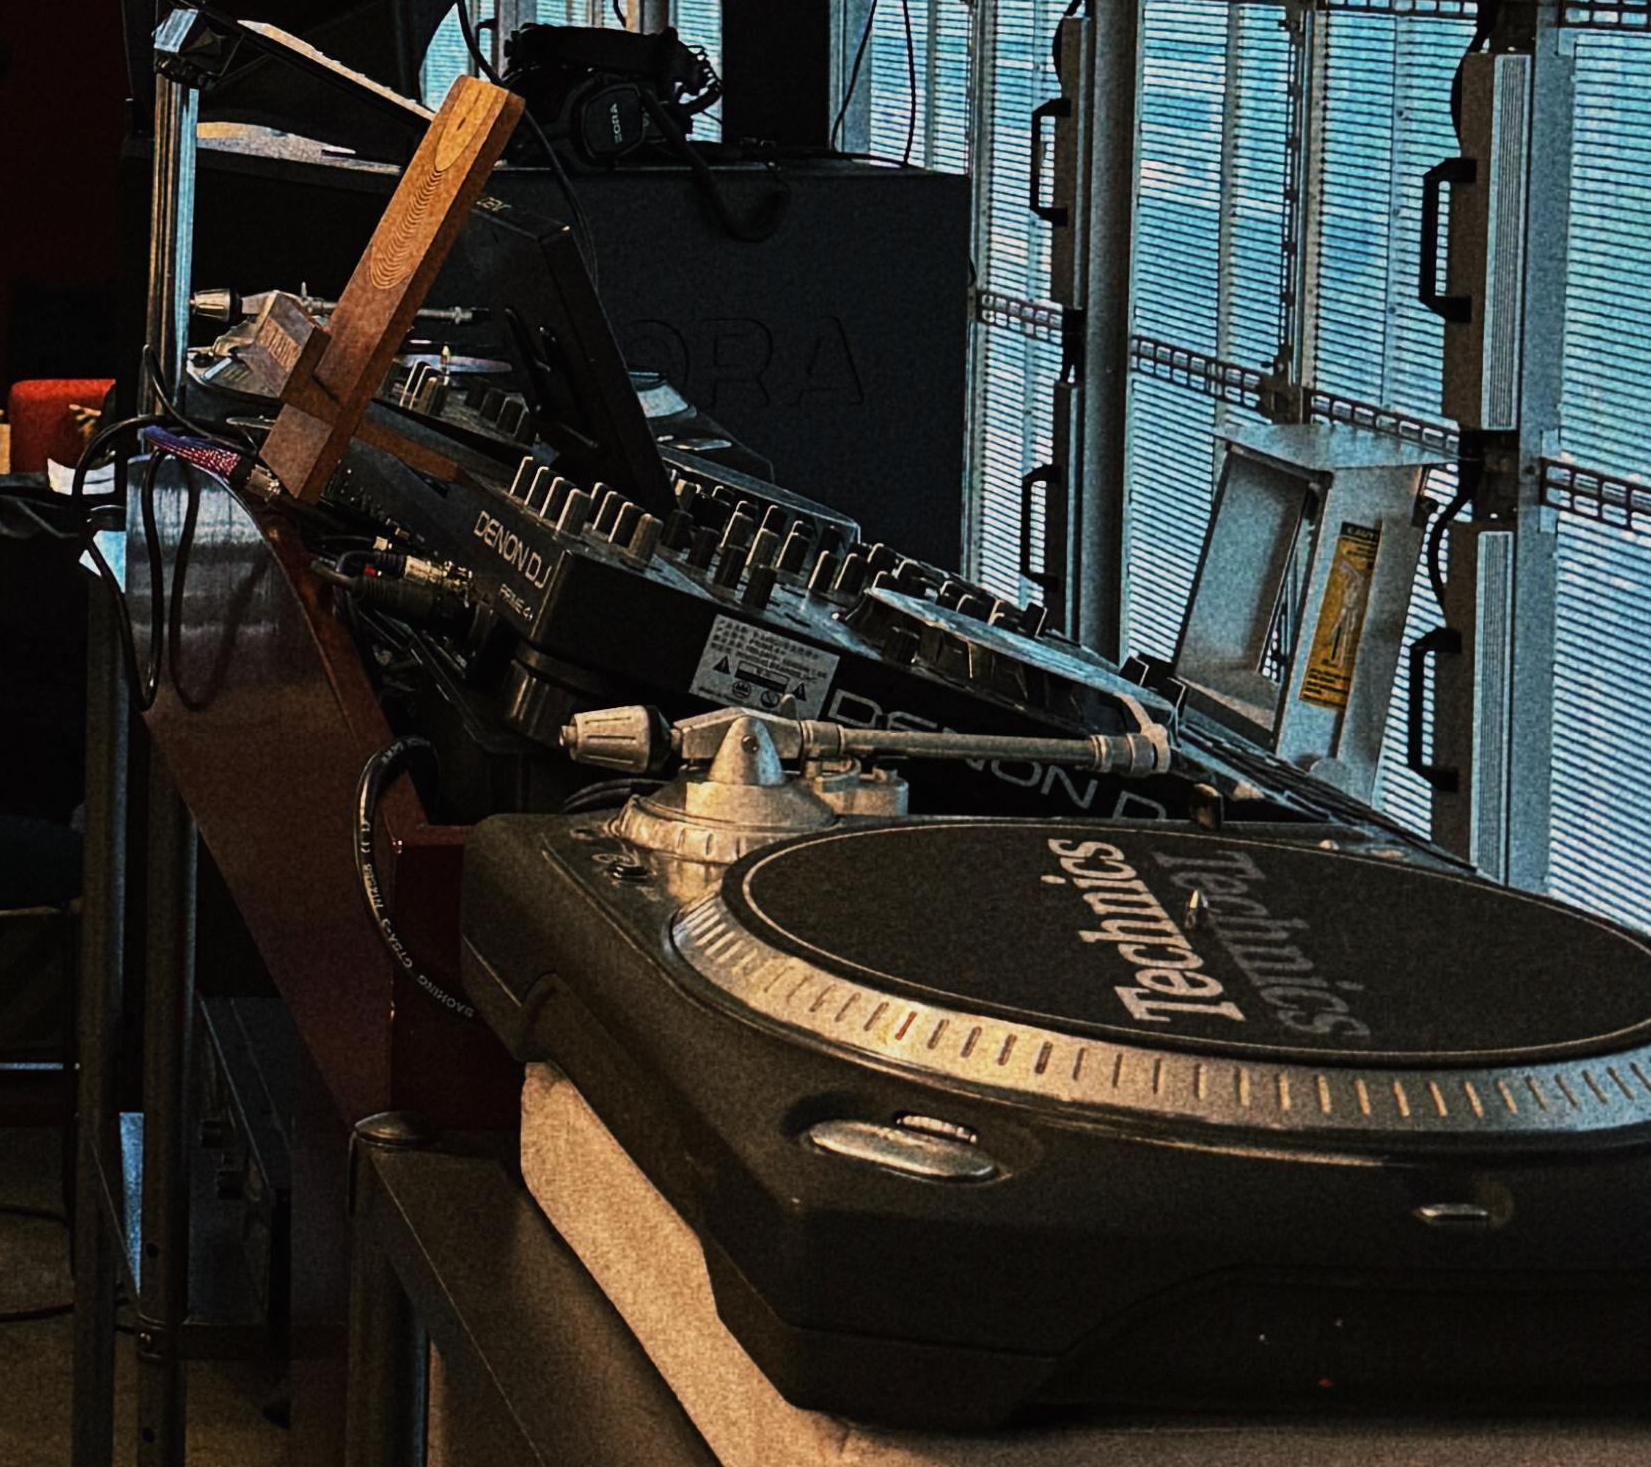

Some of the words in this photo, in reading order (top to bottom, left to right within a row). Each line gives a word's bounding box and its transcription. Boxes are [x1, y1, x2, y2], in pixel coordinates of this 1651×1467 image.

[474, 510, 531, 572] DENON
[525, 552, 553, 589] DJ
[1040, 837, 1246, 1023] Technics
[1152, 849, 1371, 1037] Technics
